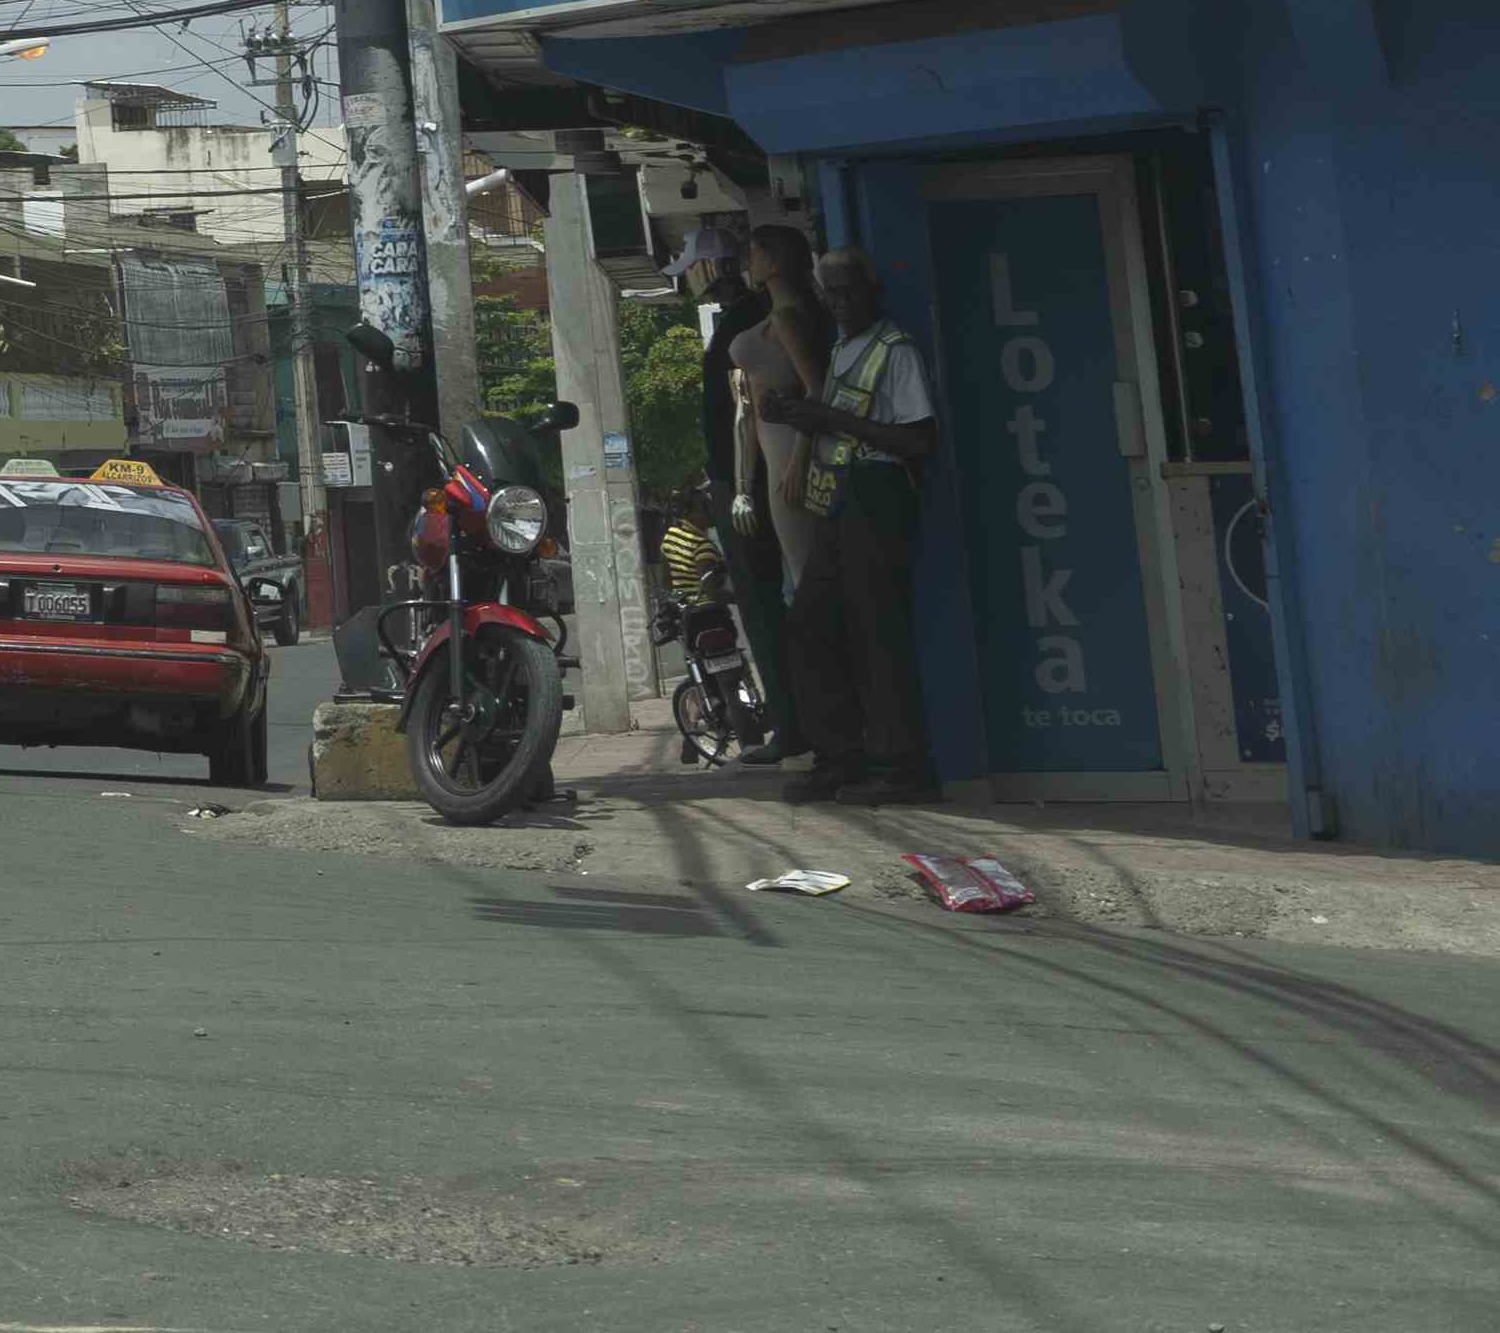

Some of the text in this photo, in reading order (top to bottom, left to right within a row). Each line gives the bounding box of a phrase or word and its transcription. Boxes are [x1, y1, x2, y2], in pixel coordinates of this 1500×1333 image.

[108, 462, 145, 475] KM-9
[989, 252, 1087, 695] Loteka
[1022, 706, 1122, 728] te toca
